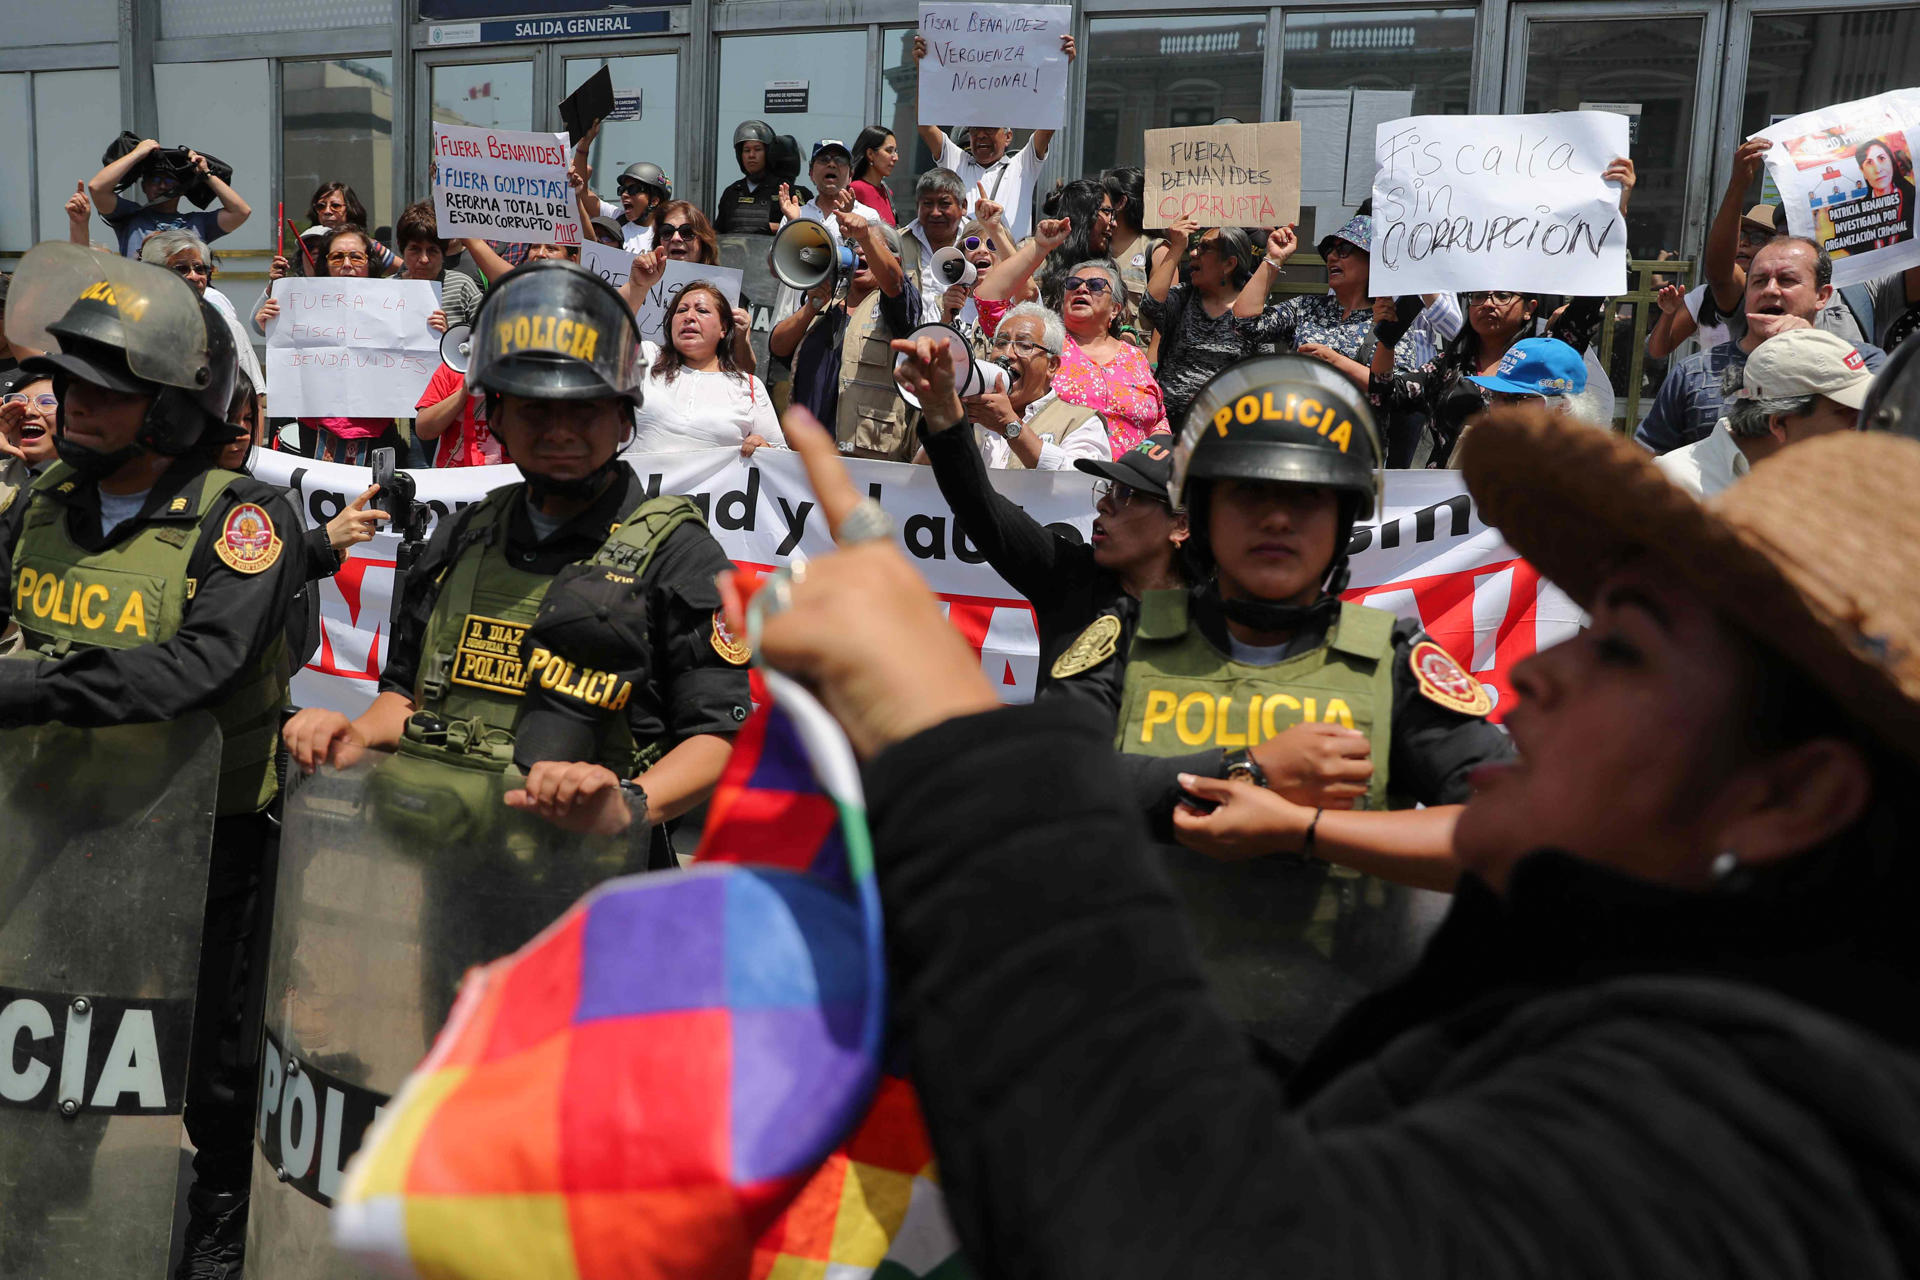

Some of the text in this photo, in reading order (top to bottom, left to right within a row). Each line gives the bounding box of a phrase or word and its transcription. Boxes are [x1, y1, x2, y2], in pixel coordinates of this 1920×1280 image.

[515, 16, 632, 37] SALIDA GENERAL
[923, 11, 1049, 34] FISCAL BENAVIDEZ
[934, 40, 1025, 67] VERGUENZA
[951, 67, 1040, 94] NACIONAL!
[487, 135, 566, 168] BENAVIDES!
[1169, 140, 1236, 166] FUERA
[1379, 126, 1584, 180] Fiscalía
[494, 174, 569, 204] GOLPISTAS!
[1160, 163, 1273, 191] BENAVIDES
[446, 192, 571, 219] REFORMA TOTAL DEL
[1158, 192, 1276, 223] CORRUPTA
[1385, 178, 1452, 222] sin
[1829, 193, 1900, 220] PATRICIA BENAVIDES
[449, 210, 553, 231] ESTADO CORRUPTO
[1834, 209, 1898, 234] INVESTIGADA POR
[1825, 220, 1908, 251] ORGANIZACIÓN CRIMINAL
[289, 292, 407, 311] FUERA LA
[291, 323, 373, 340] FISCAL
[500, 315, 599, 363] POLICIA
[1213, 391, 1353, 454] POLICIA
[488, 624, 525, 645] DIAZ
[527, 647, 633, 711] POLICIA
